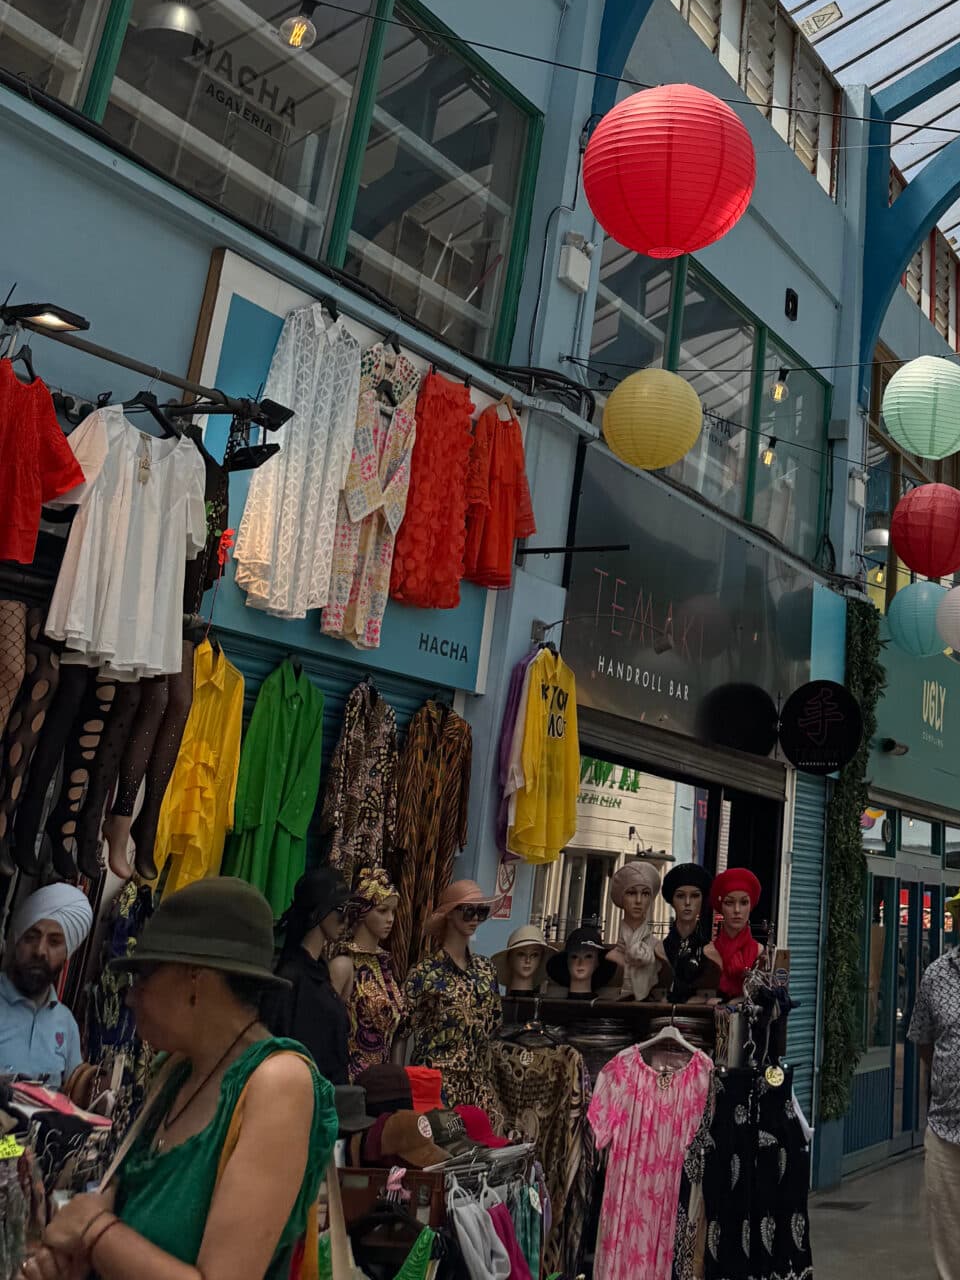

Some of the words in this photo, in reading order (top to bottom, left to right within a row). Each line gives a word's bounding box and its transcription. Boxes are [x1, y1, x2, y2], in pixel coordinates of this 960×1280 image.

[192, 36, 296, 128] HACHA
[205, 82, 273, 136] AGAVERIA
[593, 567, 704, 664] TEMAKI
[418, 632, 468, 663] HACHA
[597, 655, 662, 692] HANDROLL
[669, 679, 689, 701] BAR
[922, 679, 947, 733] UGLY
